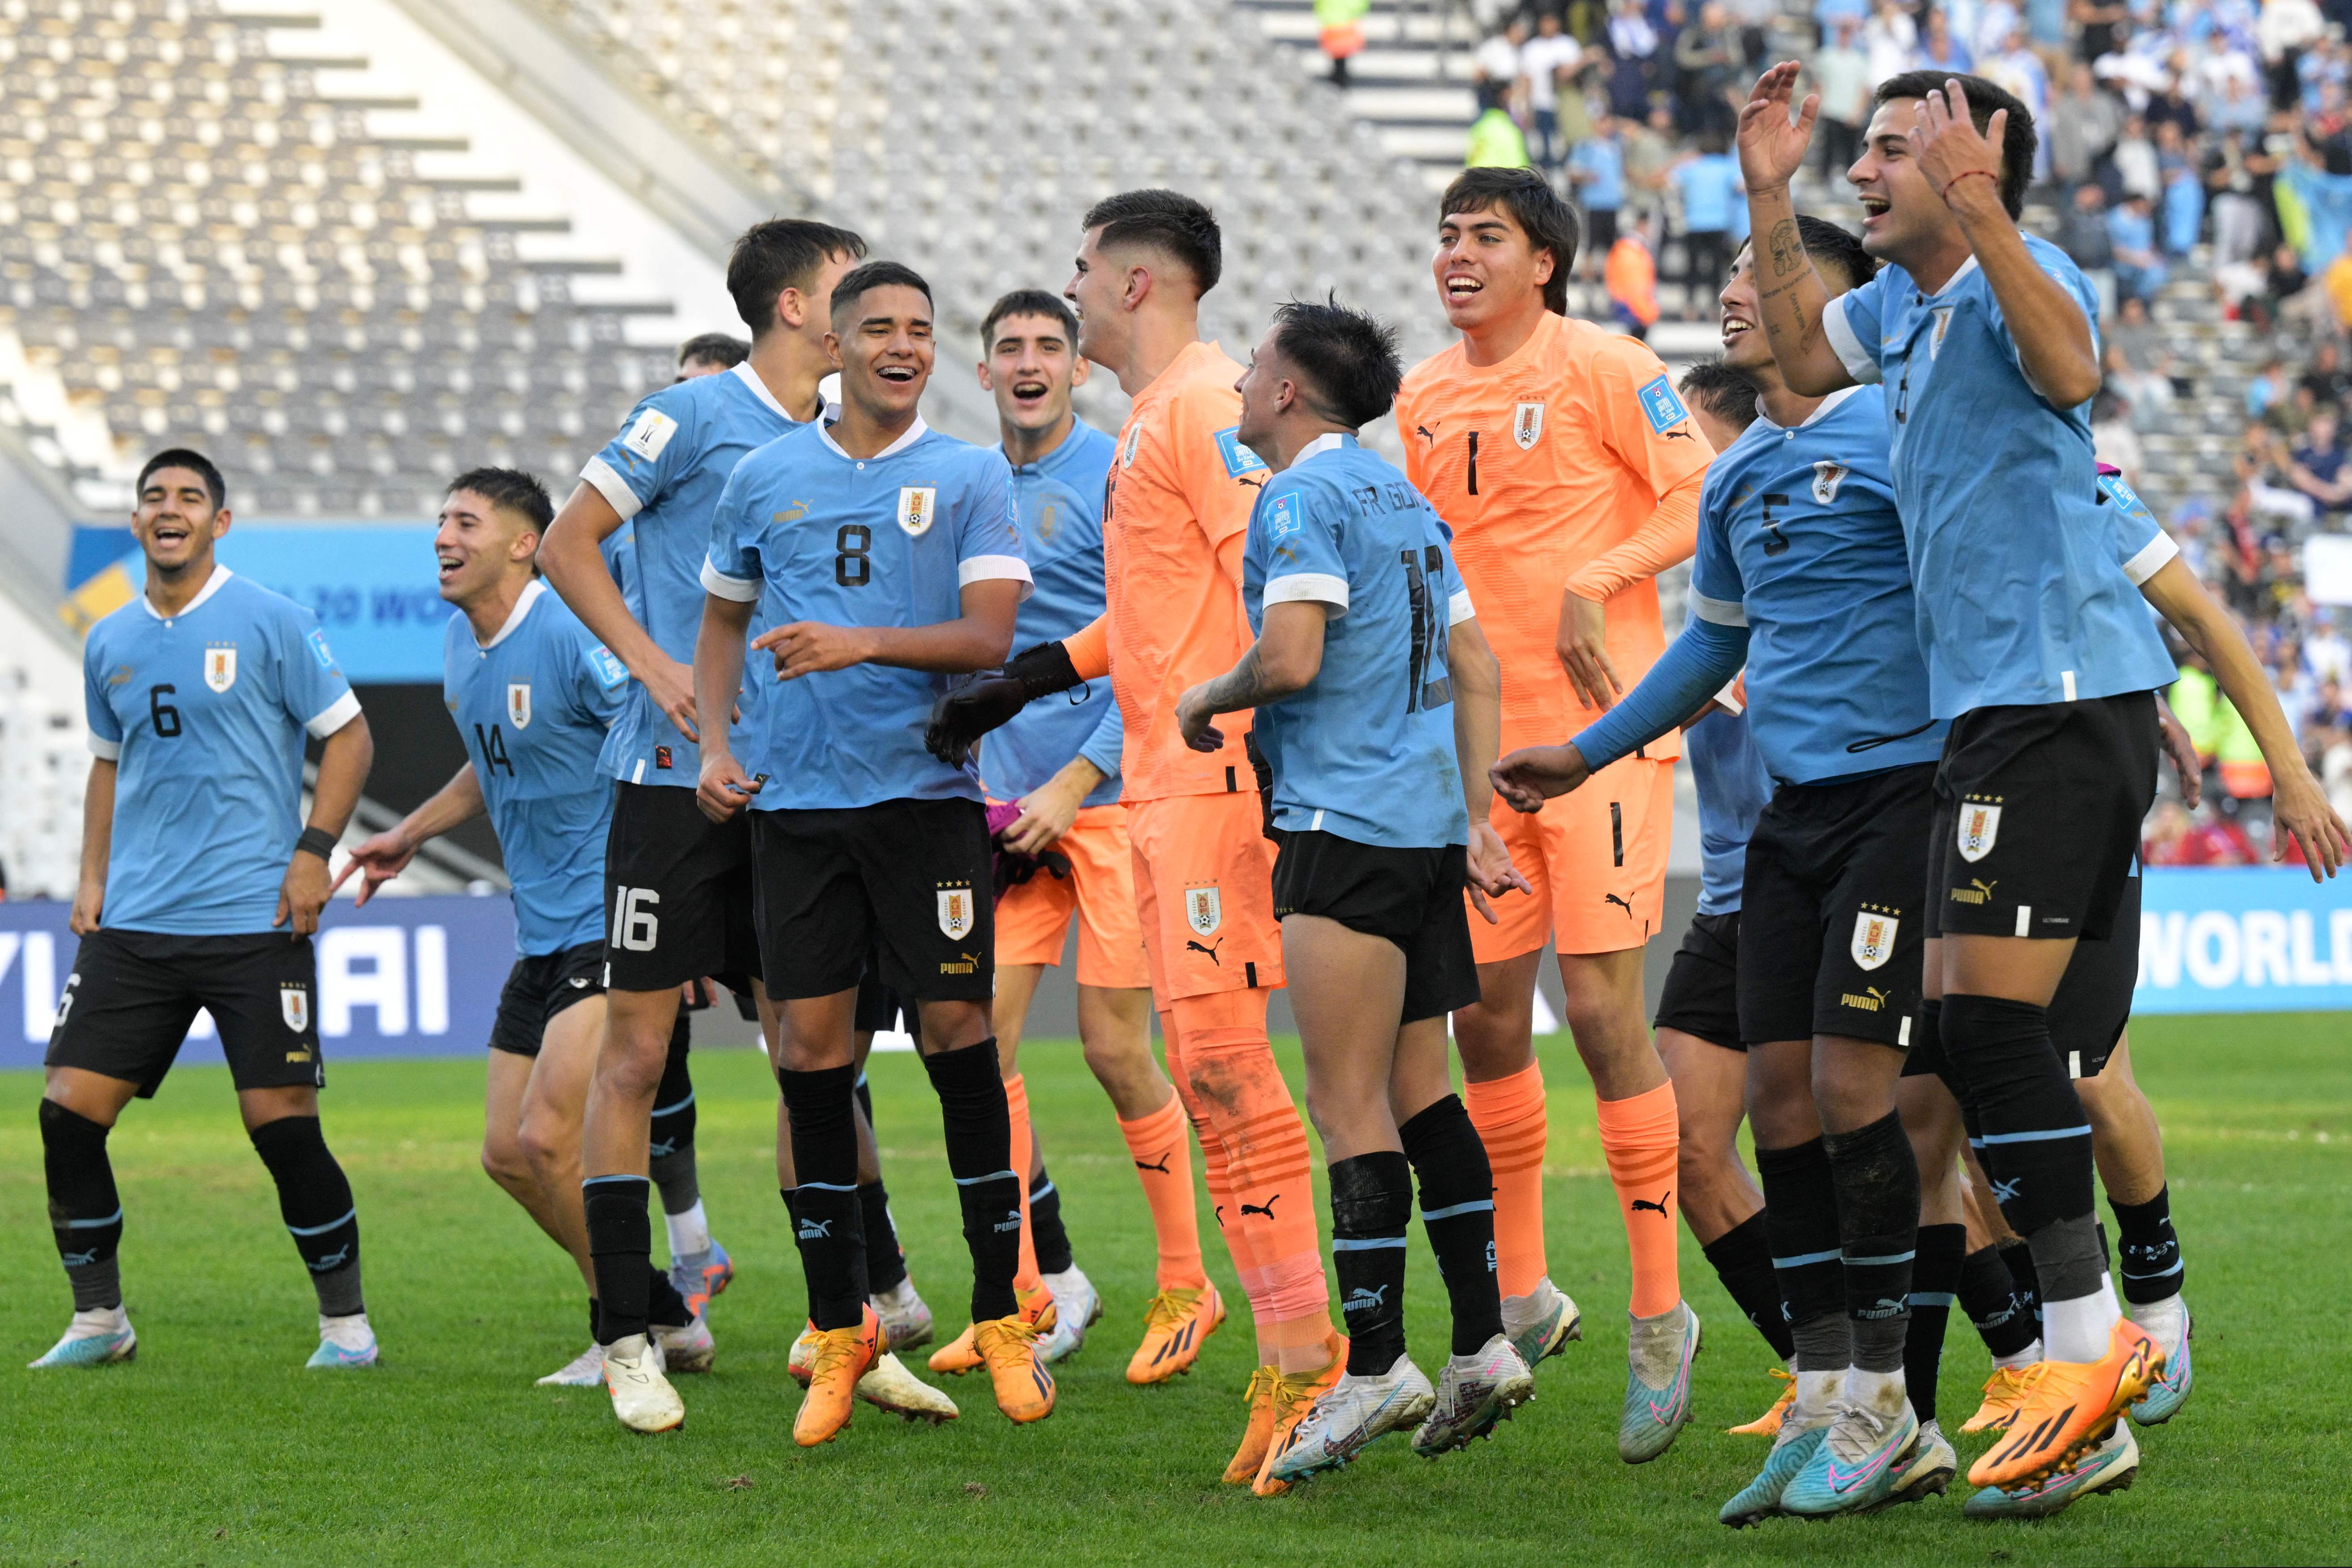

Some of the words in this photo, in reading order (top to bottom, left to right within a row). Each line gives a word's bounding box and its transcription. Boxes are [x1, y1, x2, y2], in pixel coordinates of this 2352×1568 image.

[1468, 431, 1479, 495] 1
[912, 495, 920, 511] AUF
[1352, 486, 1386, 517] FR
[773, 509, 804, 524] PUMA
[1762, 494, 1789, 557] 5
[836, 525, 871, 587] 8
[150, 685, 182, 737] 6
[475, 723, 514, 777] 14
[1610, 802, 1624, 867] 1
[1951, 888, 1984, 904] PUMA
[951, 898, 959, 916] AUF
[612, 886, 660, 951] 16
[1868, 925, 1879, 943] AUF
[941, 963, 973, 974] PUMA
[1841, 993, 1879, 1011] PUMA
[798, 1229, 823, 1239] UMA
[1485, 1241, 1497, 1272] AUF
[1343, 1298, 1376, 1312] PUMA
[1857, 1307, 1898, 1319] PUMA
